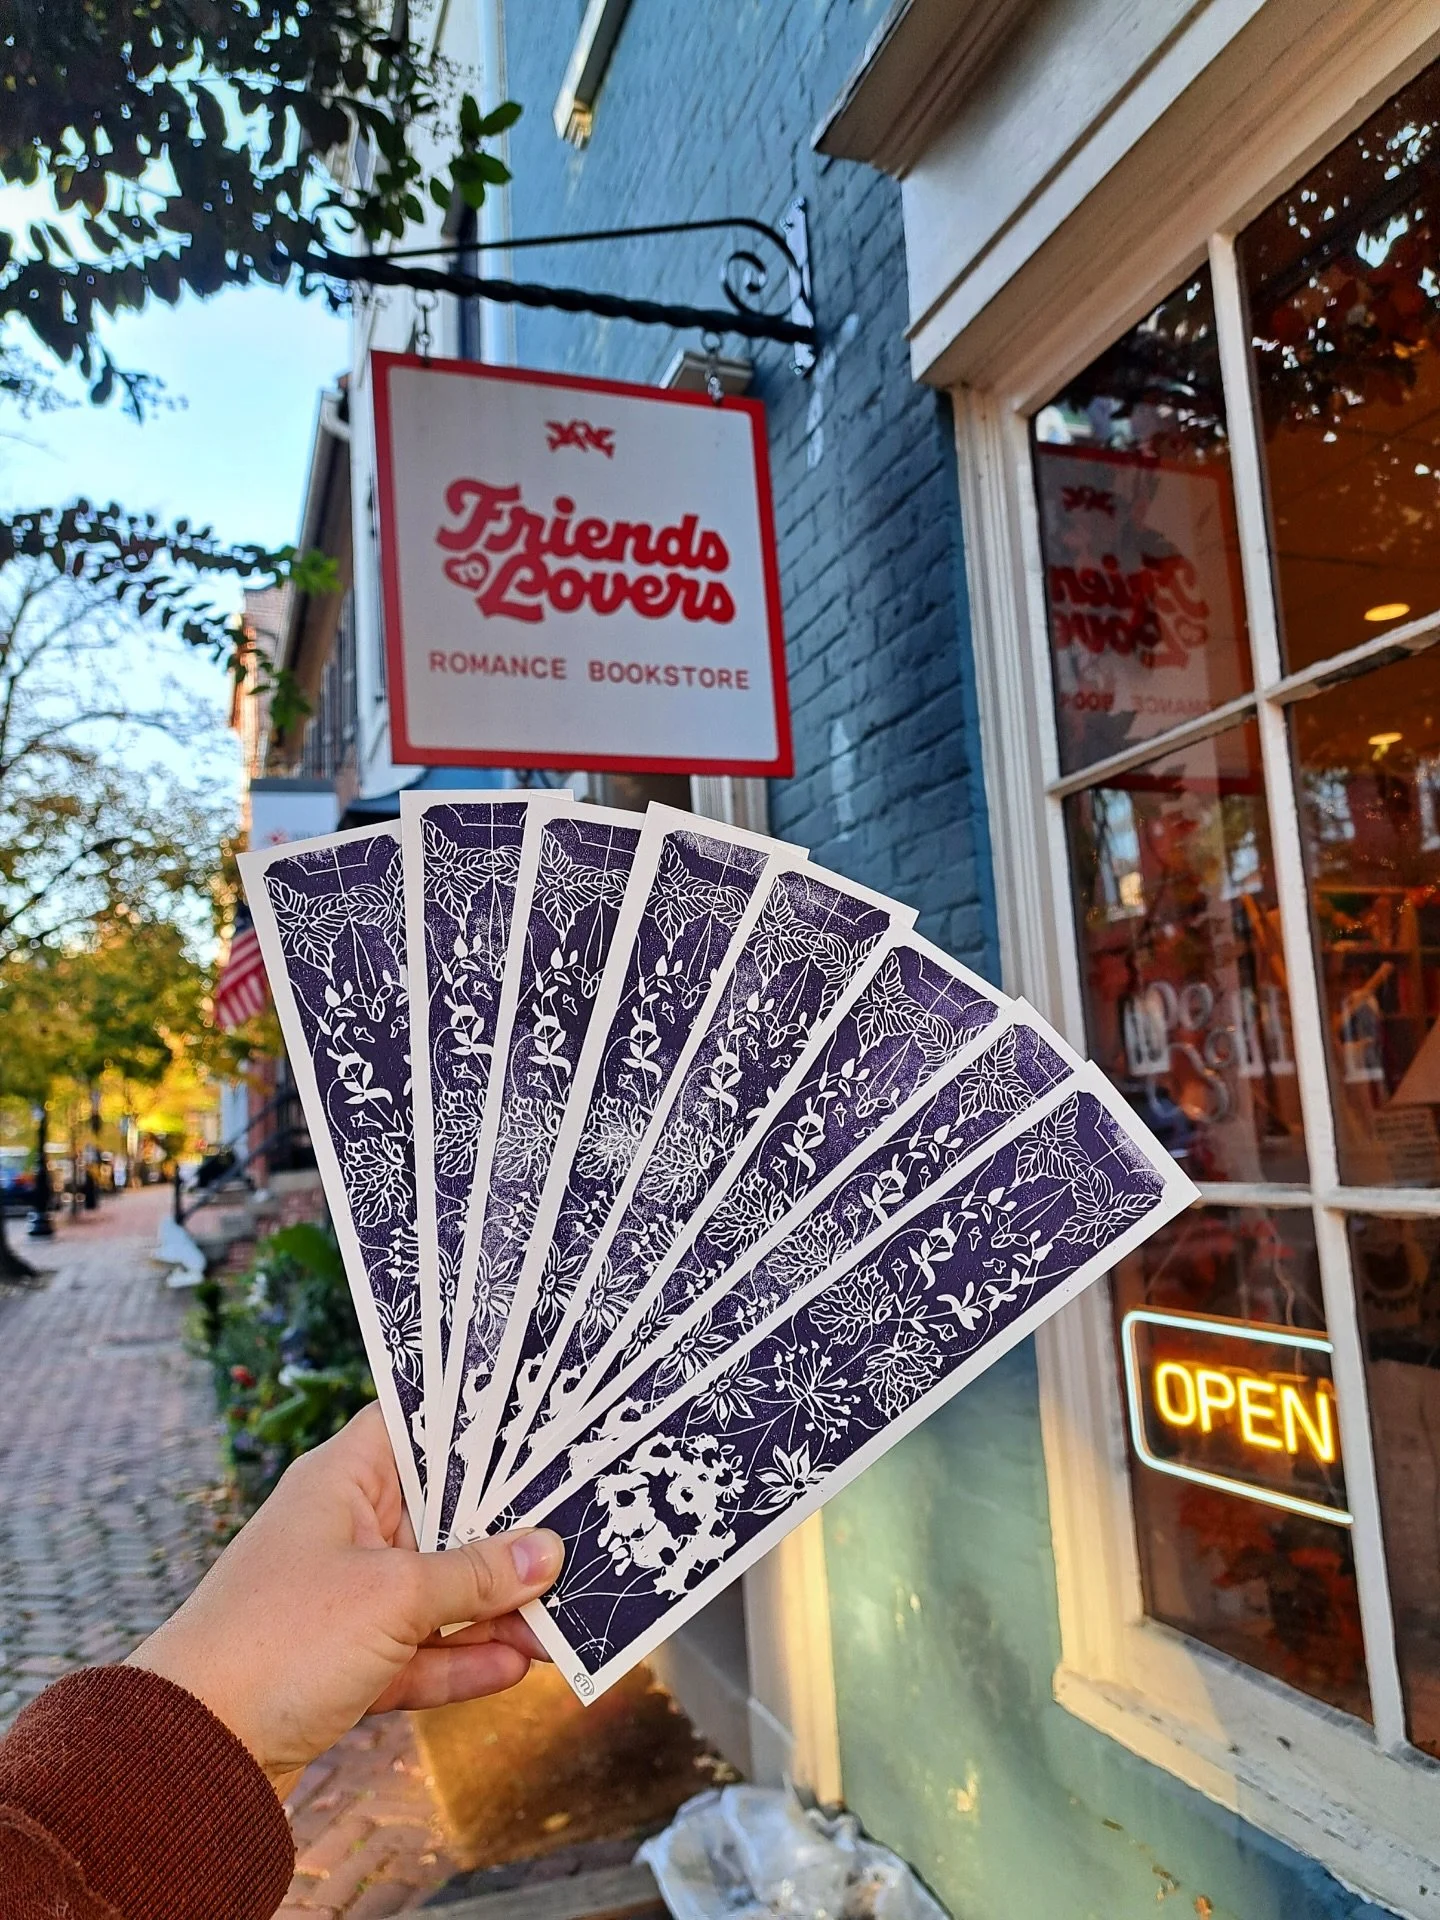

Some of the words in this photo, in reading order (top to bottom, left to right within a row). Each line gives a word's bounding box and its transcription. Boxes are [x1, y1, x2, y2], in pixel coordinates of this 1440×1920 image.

[436, 477, 731, 574] Friends
[475, 553, 736, 625] Lovers
[429, 650, 567, 681] ROMANCE
[588, 660, 750, 690] BOOKSTORE
[1154, 1360, 1337, 1464] OPEN
